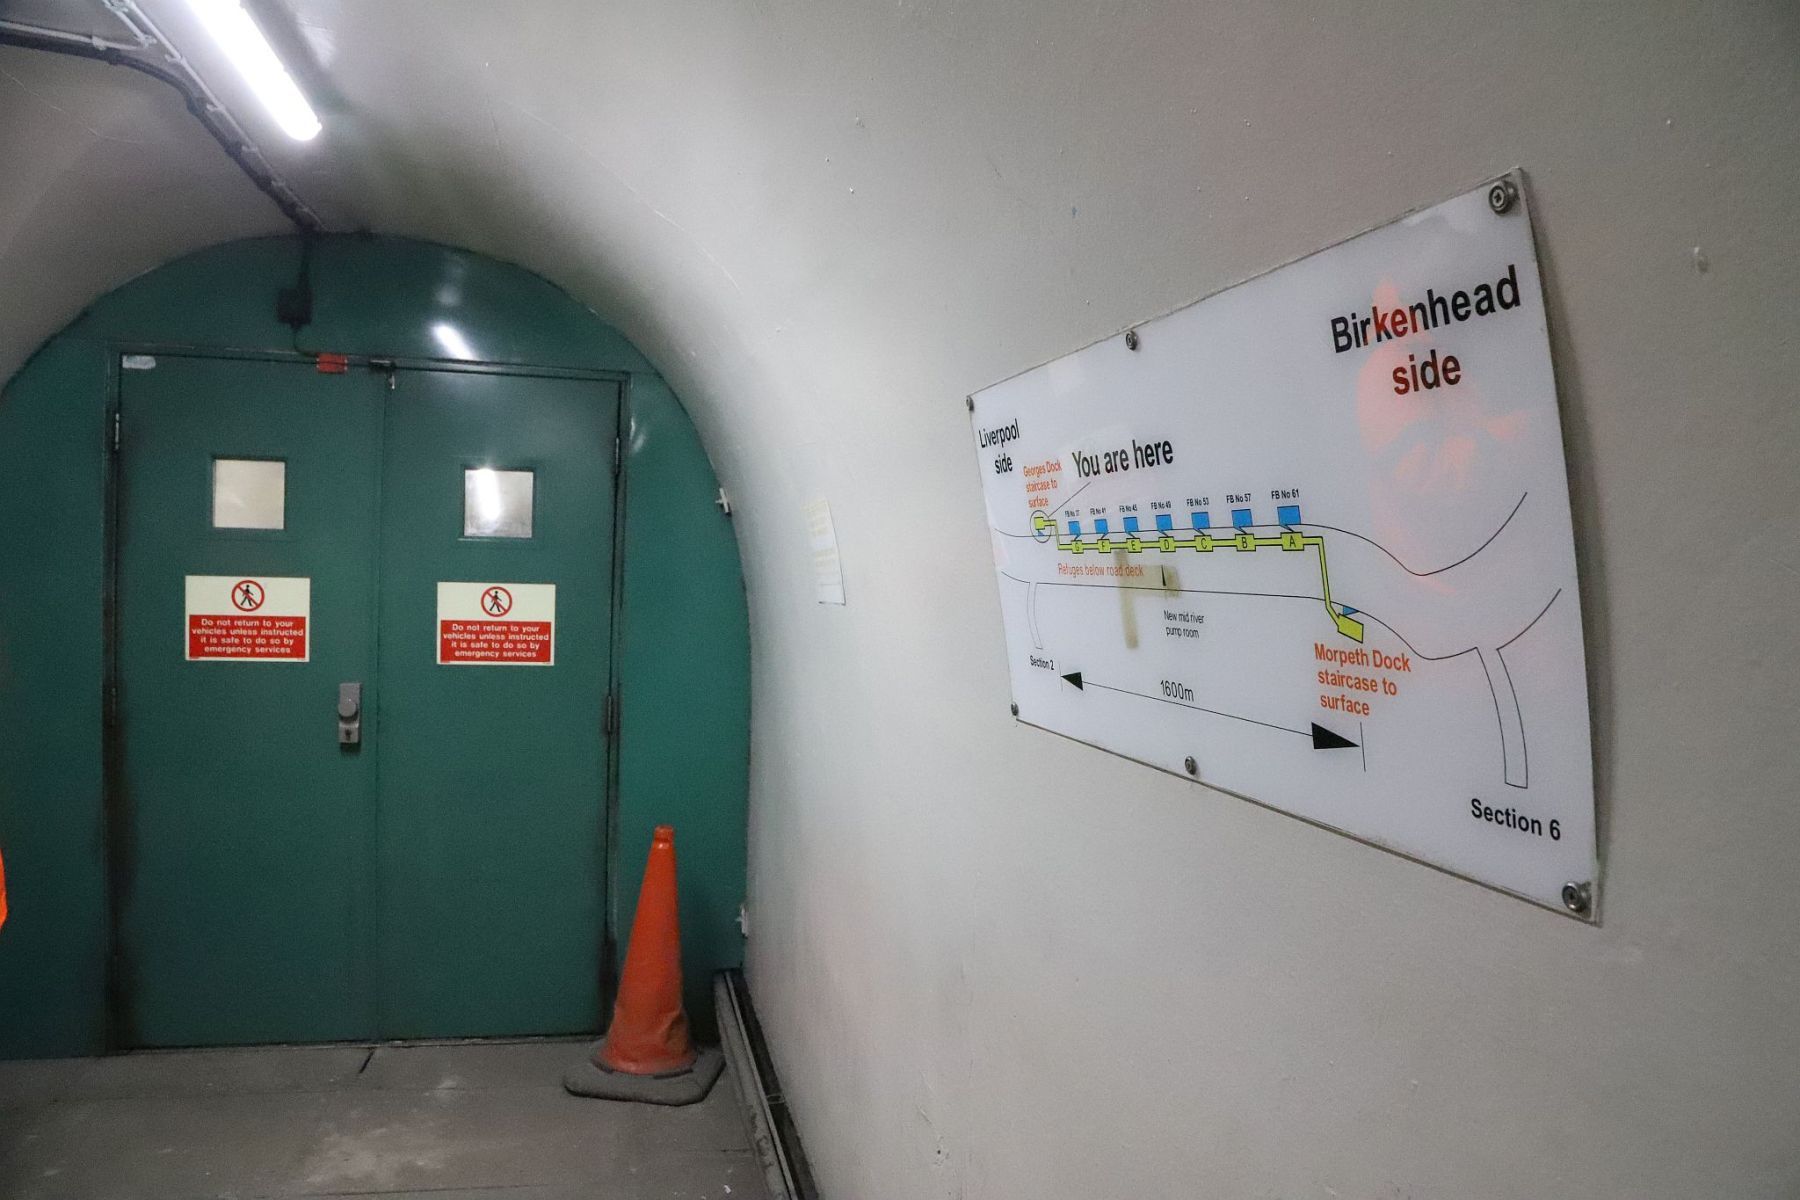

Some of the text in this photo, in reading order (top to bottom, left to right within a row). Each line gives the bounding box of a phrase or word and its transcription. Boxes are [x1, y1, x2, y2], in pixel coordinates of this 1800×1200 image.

[1330, 264, 1520, 353] Birkenhead
[1392, 349, 1461, 395] side
[979, 418, 1019, 448] Liverpool
[995, 453, 1012, 474] side
[1072, 439, 1173, 477] You are here
[1023, 459, 1062, 478] Georges Dock
[1026, 479, 1057, 492] staircase to
[1226, 493, 1251, 503] FB No 57
[1271, 489, 1299, 499] FB No 61
[1028, 496, 1048, 508] surface
[1195, 498, 1202, 506] No
[1131, 540, 1136, 550] E
[1200, 538, 1207, 549] C
[1241, 537, 1247, 548] B
[1290, 535, 1296, 548] A
[1058, 563, 1144, 578] Refuges below road deck
[1164, 610, 1204, 623] New mid river
[1166, 627, 1199, 638] pump room
[204, 646, 252, 654] emergency
[530, 642, 540, 650] by
[1030, 655, 1054, 670] Section 2
[1314, 643, 1411, 672] Morpeth Dock
[1317, 669, 1397, 696] staircase to
[1160, 680, 1194, 701] 1600m
[1320, 694, 1370, 716] surface
[1471, 799, 1561, 841] Section 6
